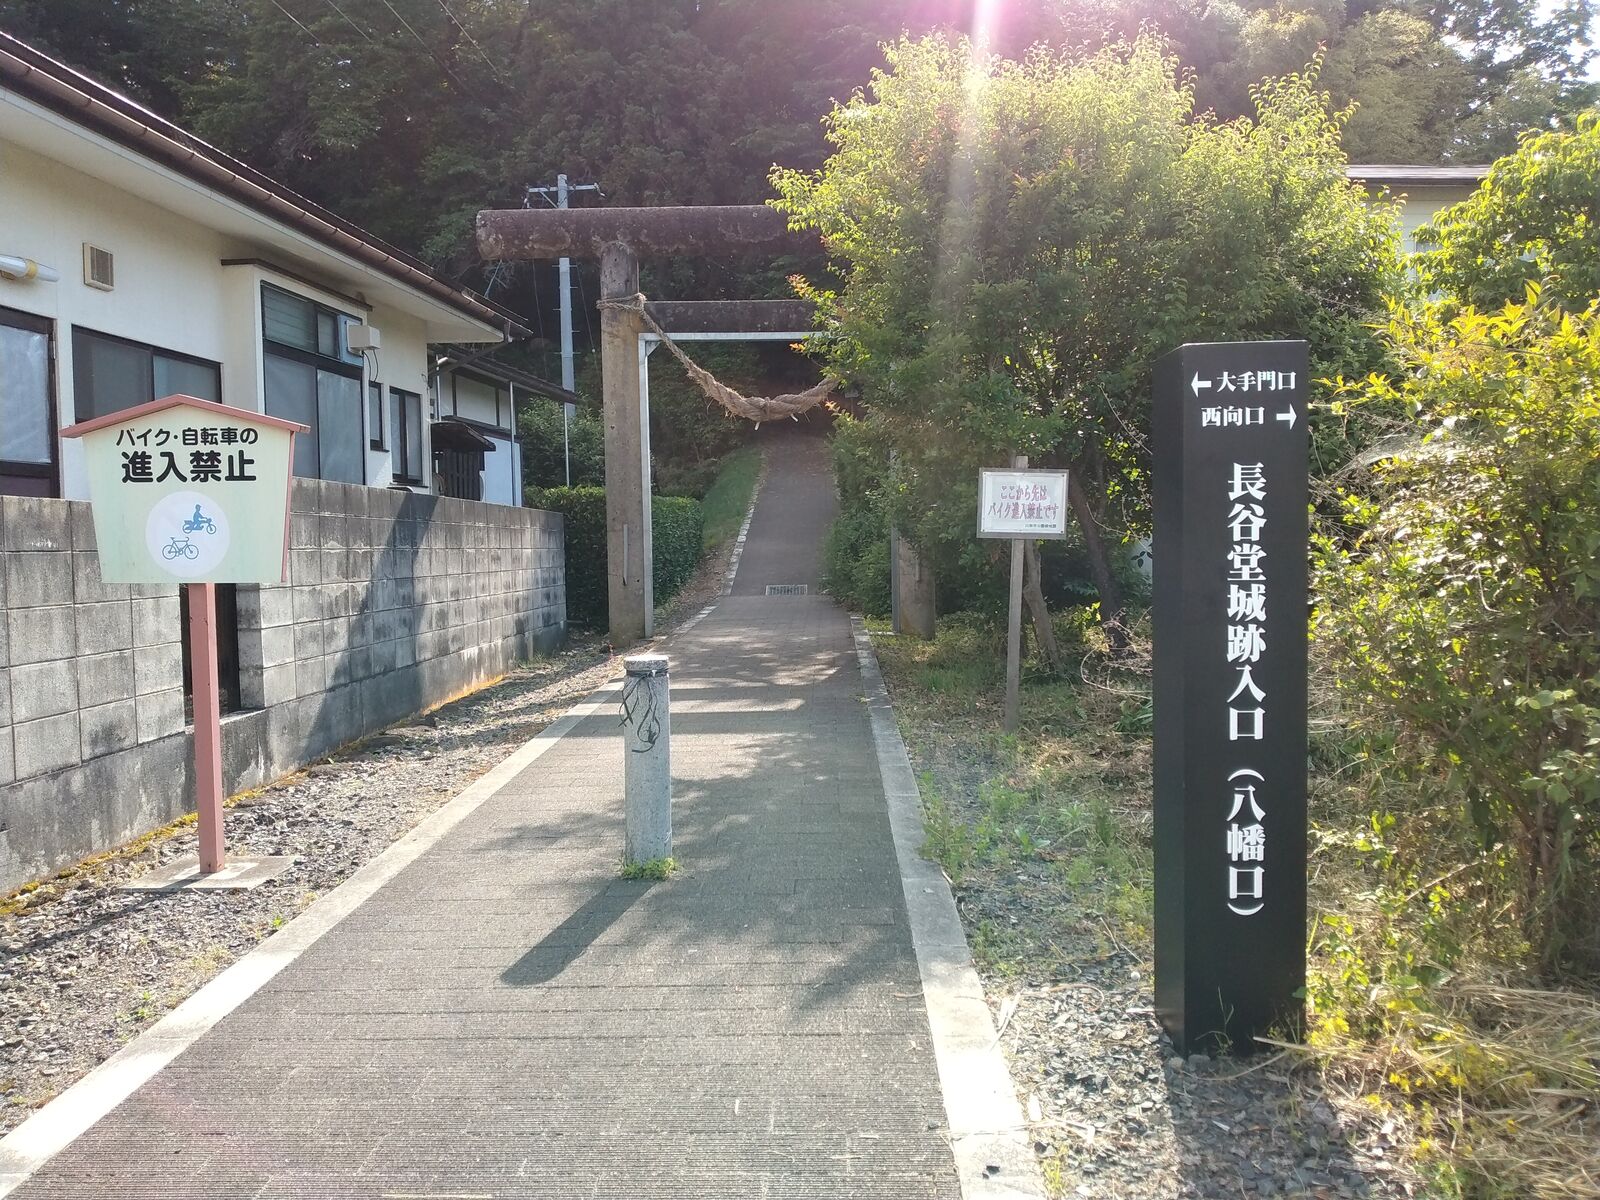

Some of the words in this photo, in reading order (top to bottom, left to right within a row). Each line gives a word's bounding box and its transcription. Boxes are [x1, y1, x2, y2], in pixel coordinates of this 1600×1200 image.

[1216, 370, 1297, 393] 大手門口
[1201, 405, 1266, 428] 西向口
[116, 427, 258, 447] バイク・自転車の
[121, 450, 257, 483] 進入禁止
[1000, 484, 1048, 501] ここから先は
